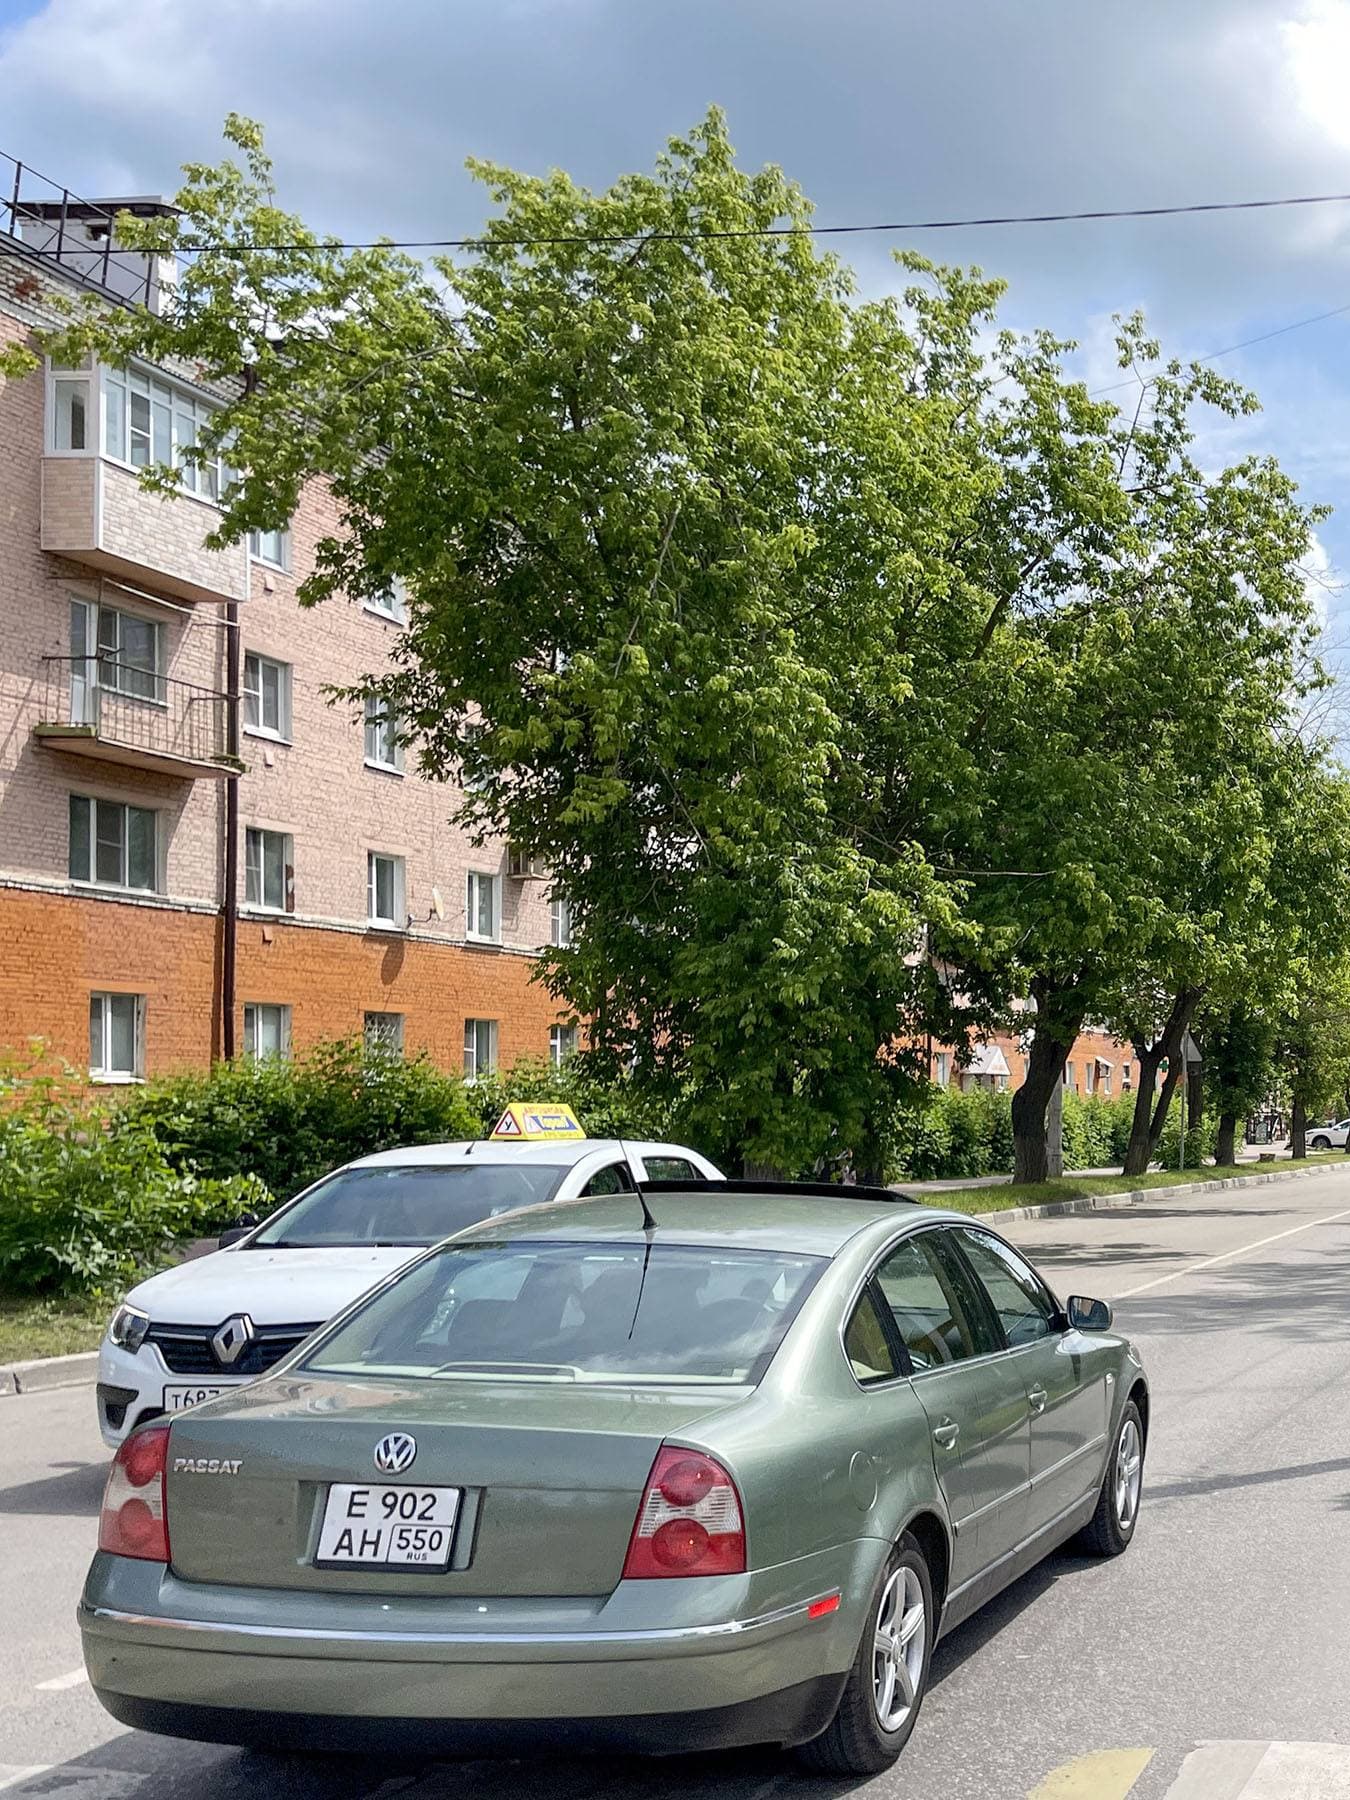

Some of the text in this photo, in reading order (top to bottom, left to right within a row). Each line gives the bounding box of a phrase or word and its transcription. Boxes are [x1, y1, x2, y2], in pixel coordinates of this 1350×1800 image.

[173, 1458, 243, 1475] PASSAT
[381, 1491, 437, 1521] 902
[396, 1529, 443, 1552] 550
[406, 1552, 428, 1561] RUS
